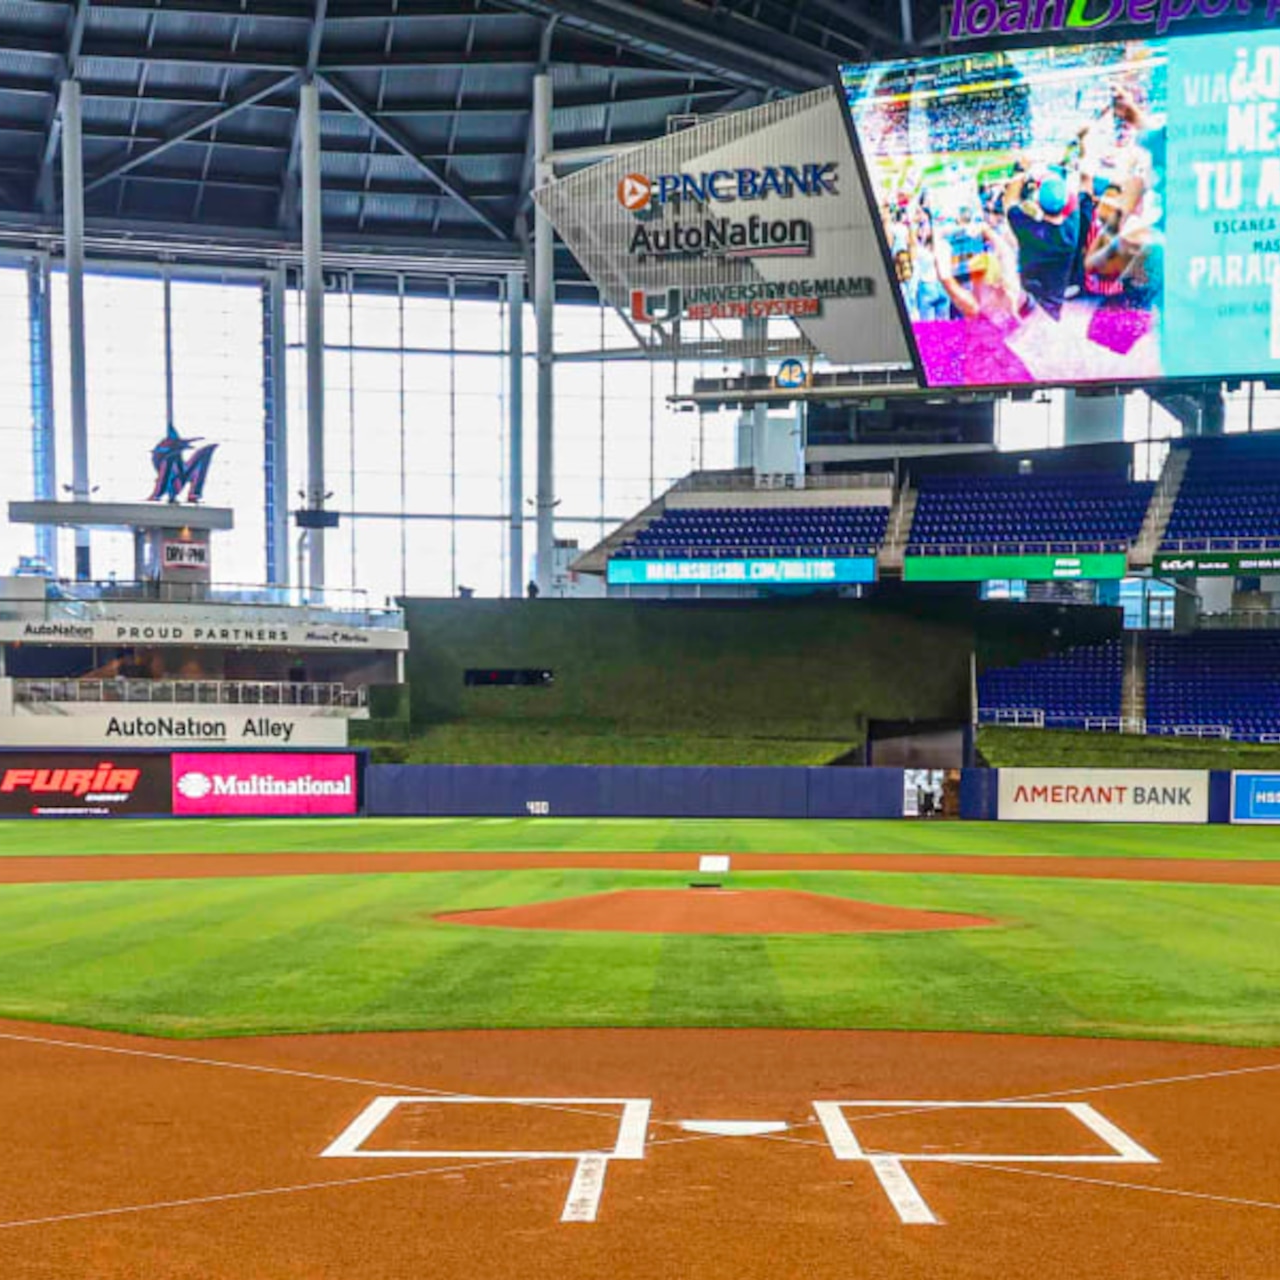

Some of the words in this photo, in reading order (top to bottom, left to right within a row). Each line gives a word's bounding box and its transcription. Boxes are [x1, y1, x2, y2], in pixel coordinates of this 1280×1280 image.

[1194, 160, 1242, 210] TU
[629, 215, 808, 253] AutoNation
[753, 299, 819, 317] SYSTEM
[778, 364, 803, 381] 42
[117, 627, 183, 639] PROUD
[194, 628, 289, 641] PARTNERS
[105, 717, 226, 737] AutoNation
[242, 717, 295, 742] Alley
[213, 774, 351, 796] Multinational
[1013, 785, 1128, 803] AMERANT
[1133, 786, 1192, 805] BANK
